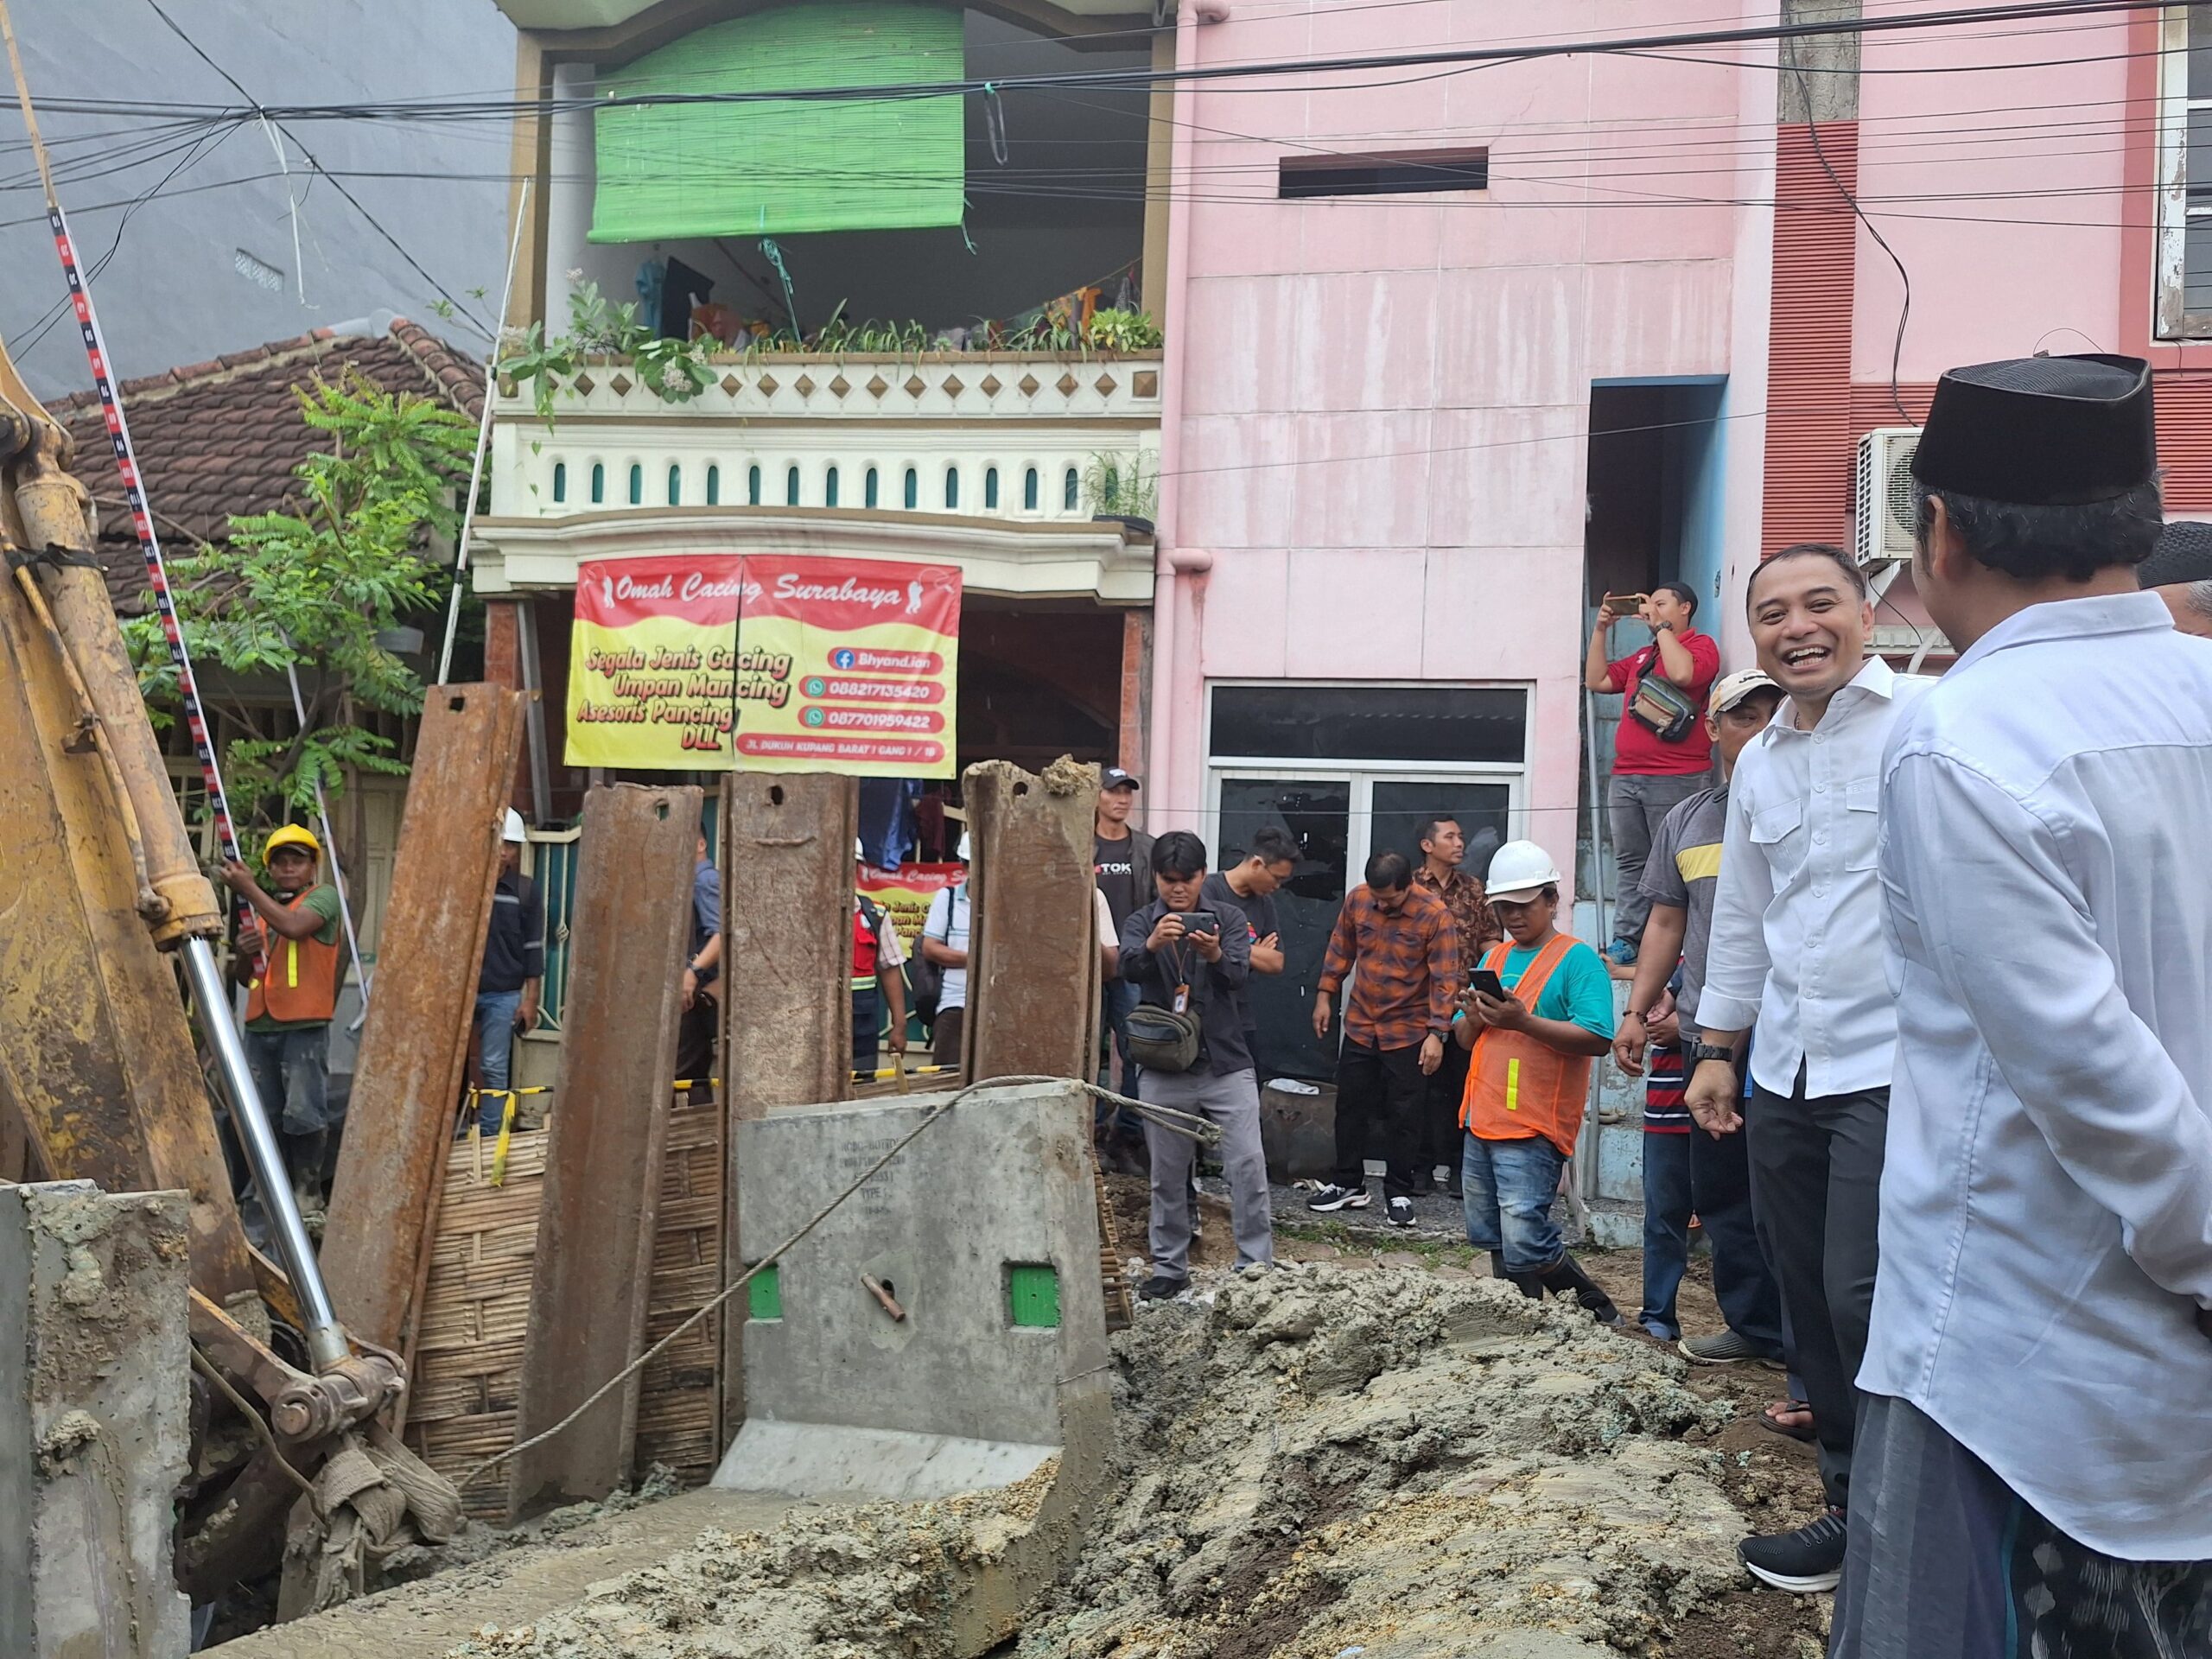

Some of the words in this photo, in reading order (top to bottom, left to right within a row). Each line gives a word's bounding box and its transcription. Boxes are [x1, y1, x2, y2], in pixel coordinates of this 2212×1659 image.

[617, 574, 673, 600] Omah
[681, 571, 764, 604] Cacing
[774, 573, 901, 610] Surabaya
[585, 646, 645, 677] Segala
[649, 645, 702, 670] Jenis
[707, 645, 793, 680] Cacing
[613, 673, 682, 702] Umpan
[687, 673, 791, 708] Mancing
[576, 699, 646, 723] Asesoris
[652, 699, 737, 733] Pancing
[829, 711, 931, 728] 087701959422
[681, 725, 722, 750] DLL
[760, 740, 795, 751] DUKUH
[797, 741, 836, 753] KUPANG
[837, 743, 871, 754] BARAT
[878, 745, 906, 756] GANG
